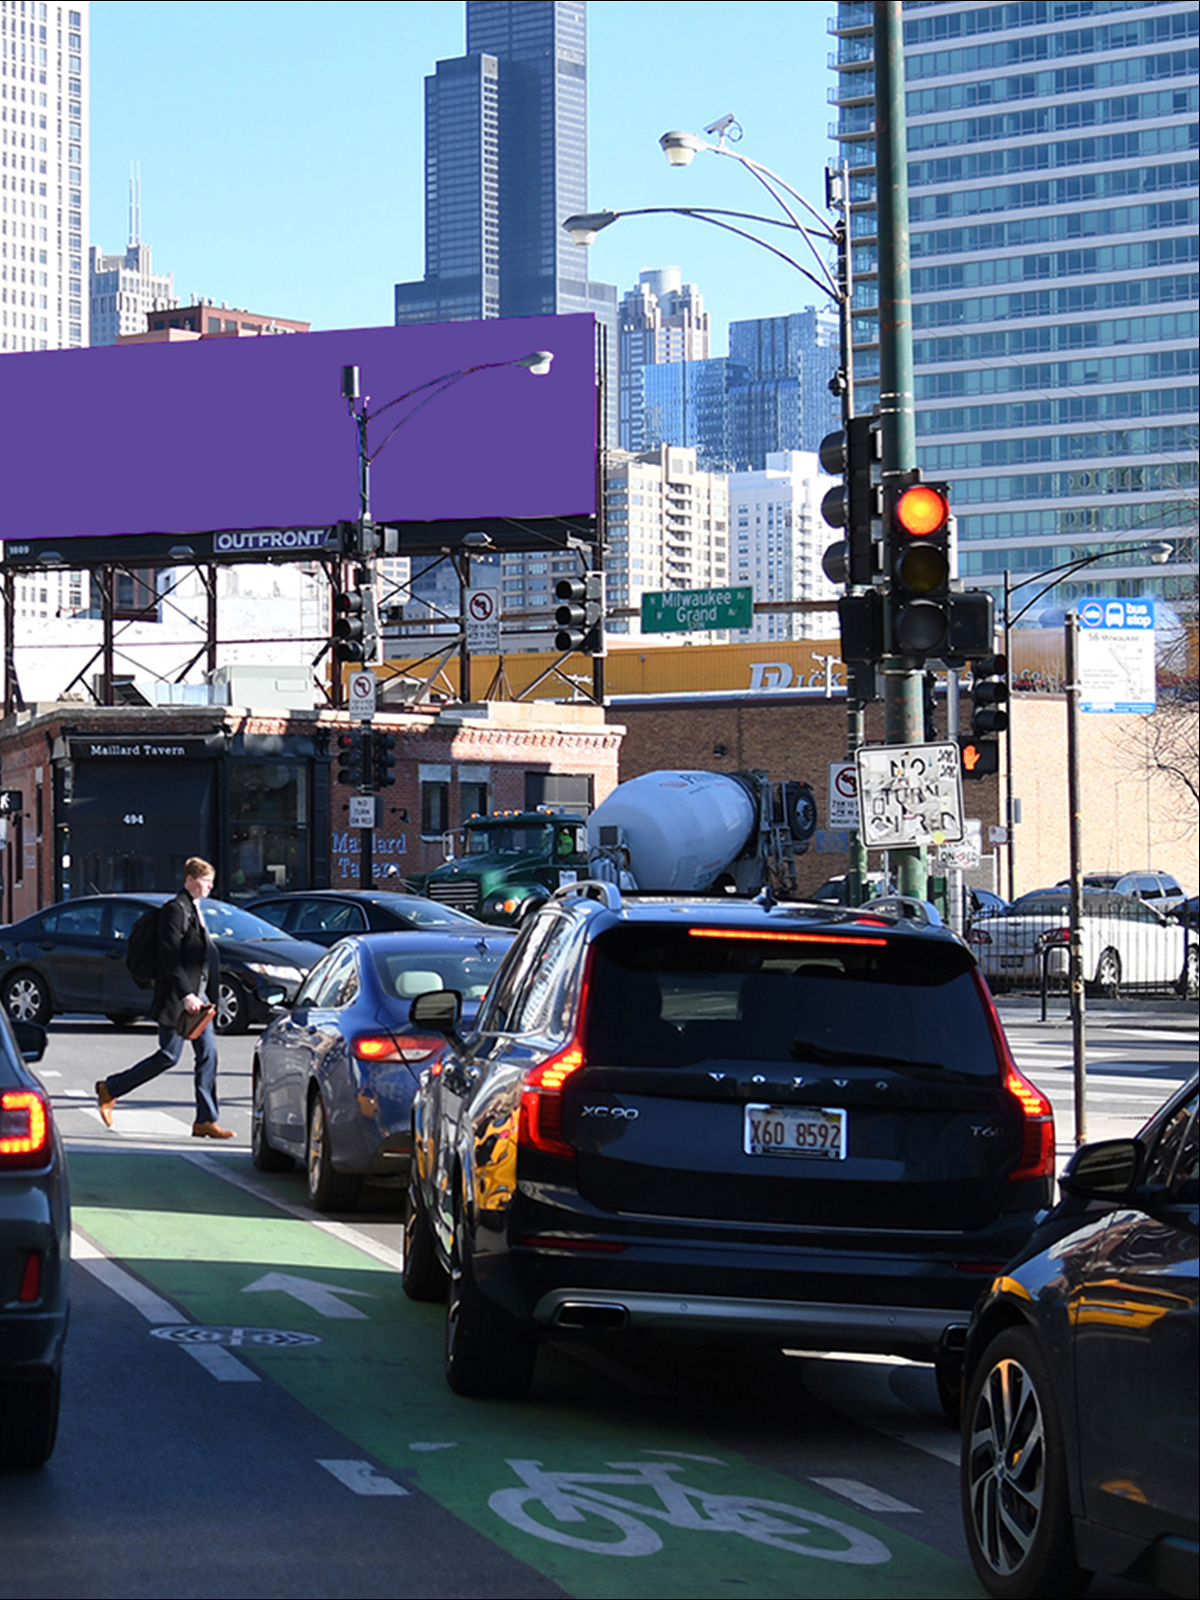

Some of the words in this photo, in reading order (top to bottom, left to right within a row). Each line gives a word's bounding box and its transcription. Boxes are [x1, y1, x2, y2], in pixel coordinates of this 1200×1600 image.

[217, 529, 325, 550] OUTFRONT
[661, 591, 732, 608] Milwaukee
[676, 606, 717, 623] Grand
[1126, 602, 1148, 615] bus
[1126, 615, 1152, 628] stop
[90, 744, 141, 756] Maillard
[143, 744, 186, 756] Tavern
[890, 758, 927, 778] NO
[123, 814, 144, 825] 494
[331, 831, 407, 854] Malard
[338, 856, 400, 878] Taern
[581, 1105, 639, 1120] XC90
[751, 1119, 785, 1146] X60
[795, 1121, 842, 1149] 8592
